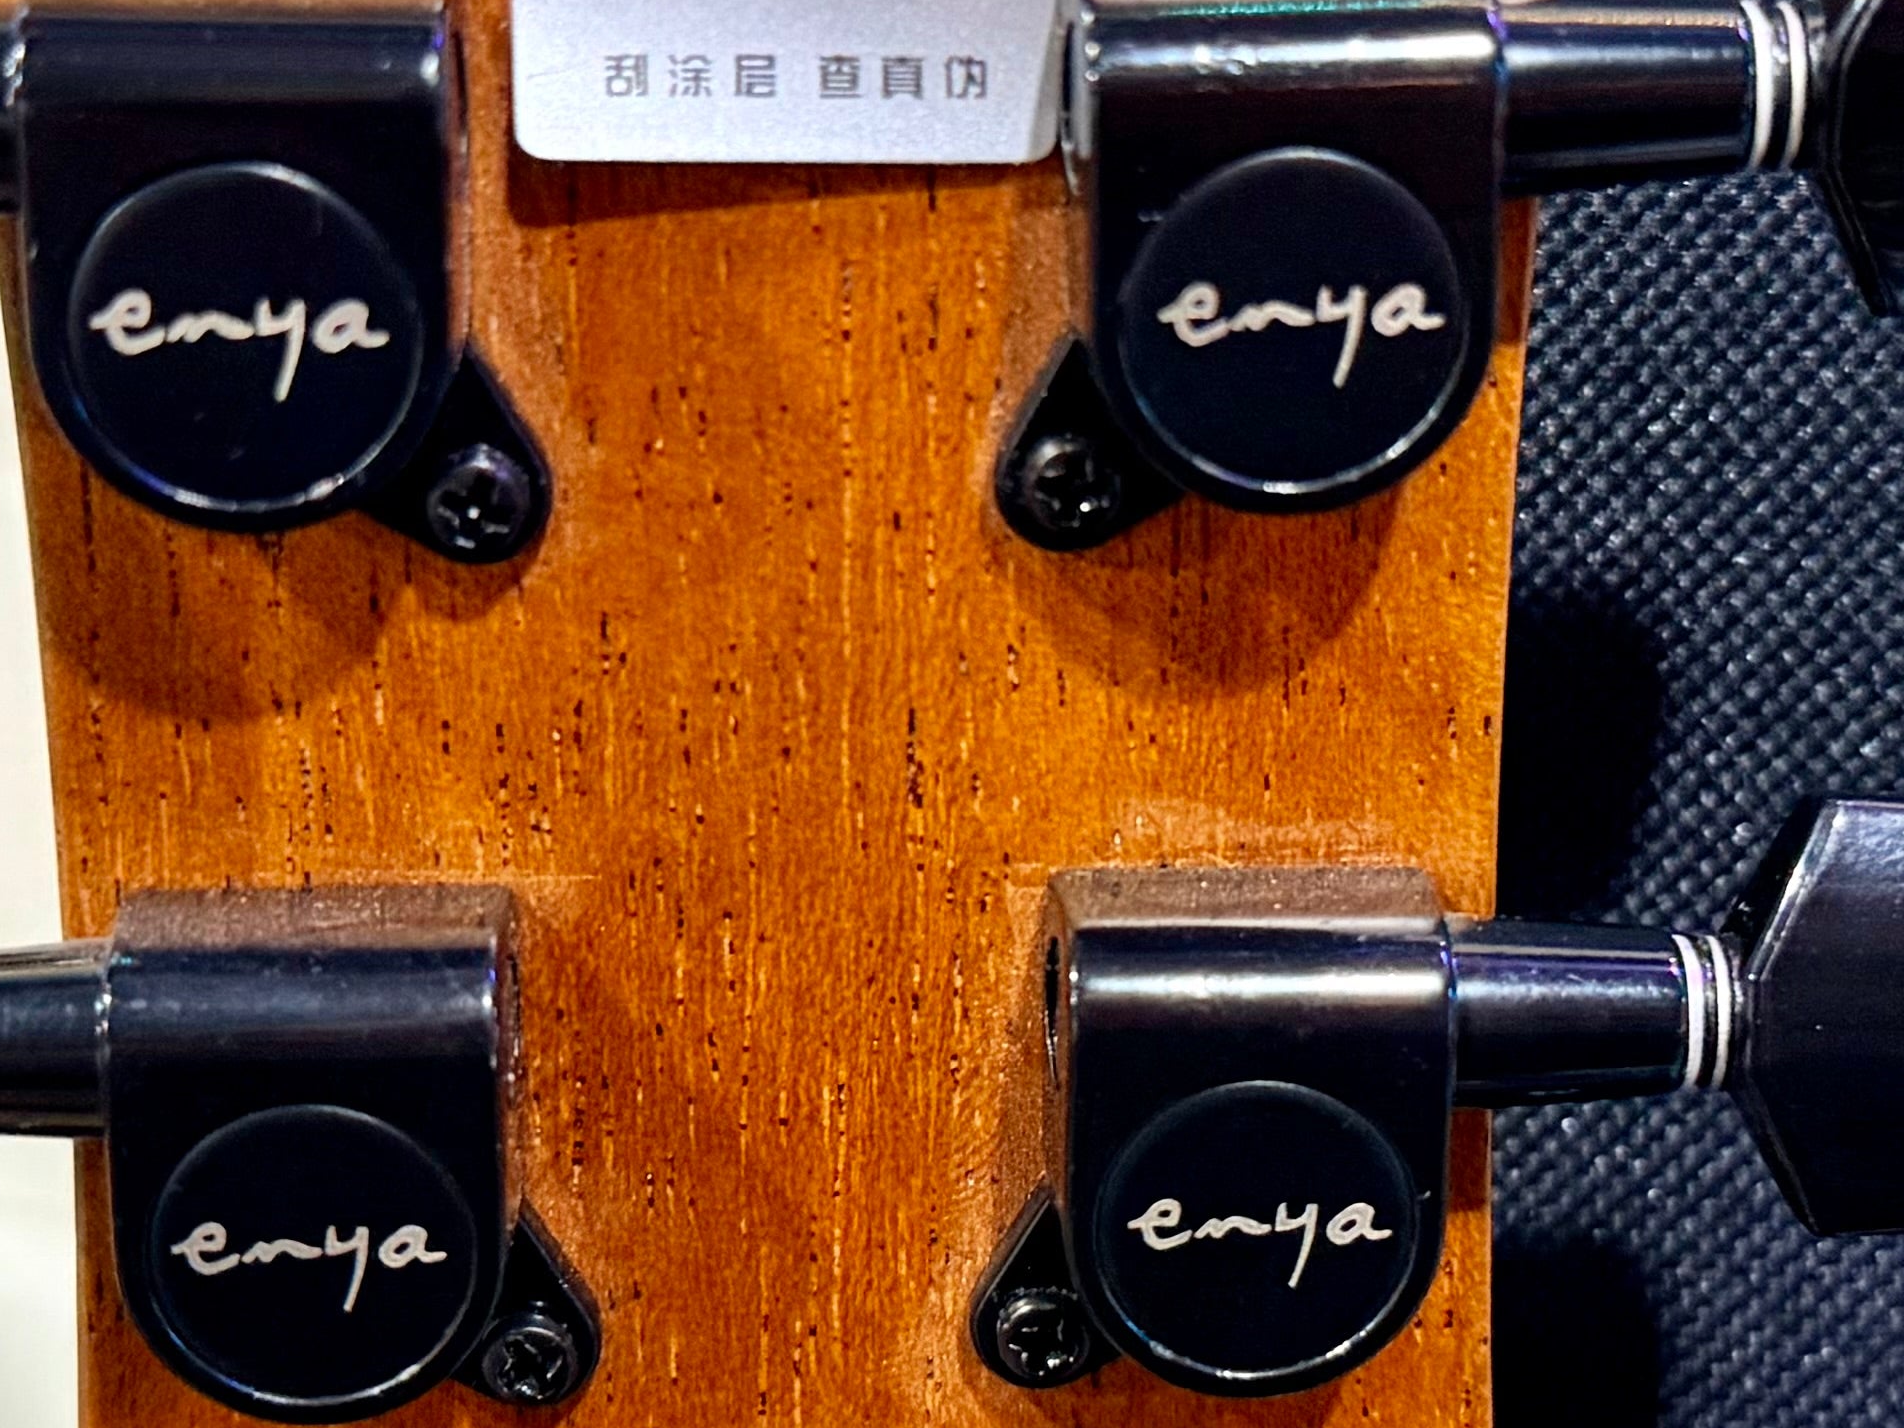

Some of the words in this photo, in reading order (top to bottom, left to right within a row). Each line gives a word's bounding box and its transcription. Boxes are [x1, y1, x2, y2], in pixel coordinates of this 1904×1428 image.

[603, 54, 778, 99] 刮涂层
[89, 288, 391, 402] enya
[1157, 282, 1446, 388] enya
[170, 1221, 449, 1312] enya
[1126, 1197, 1394, 1288] enya
